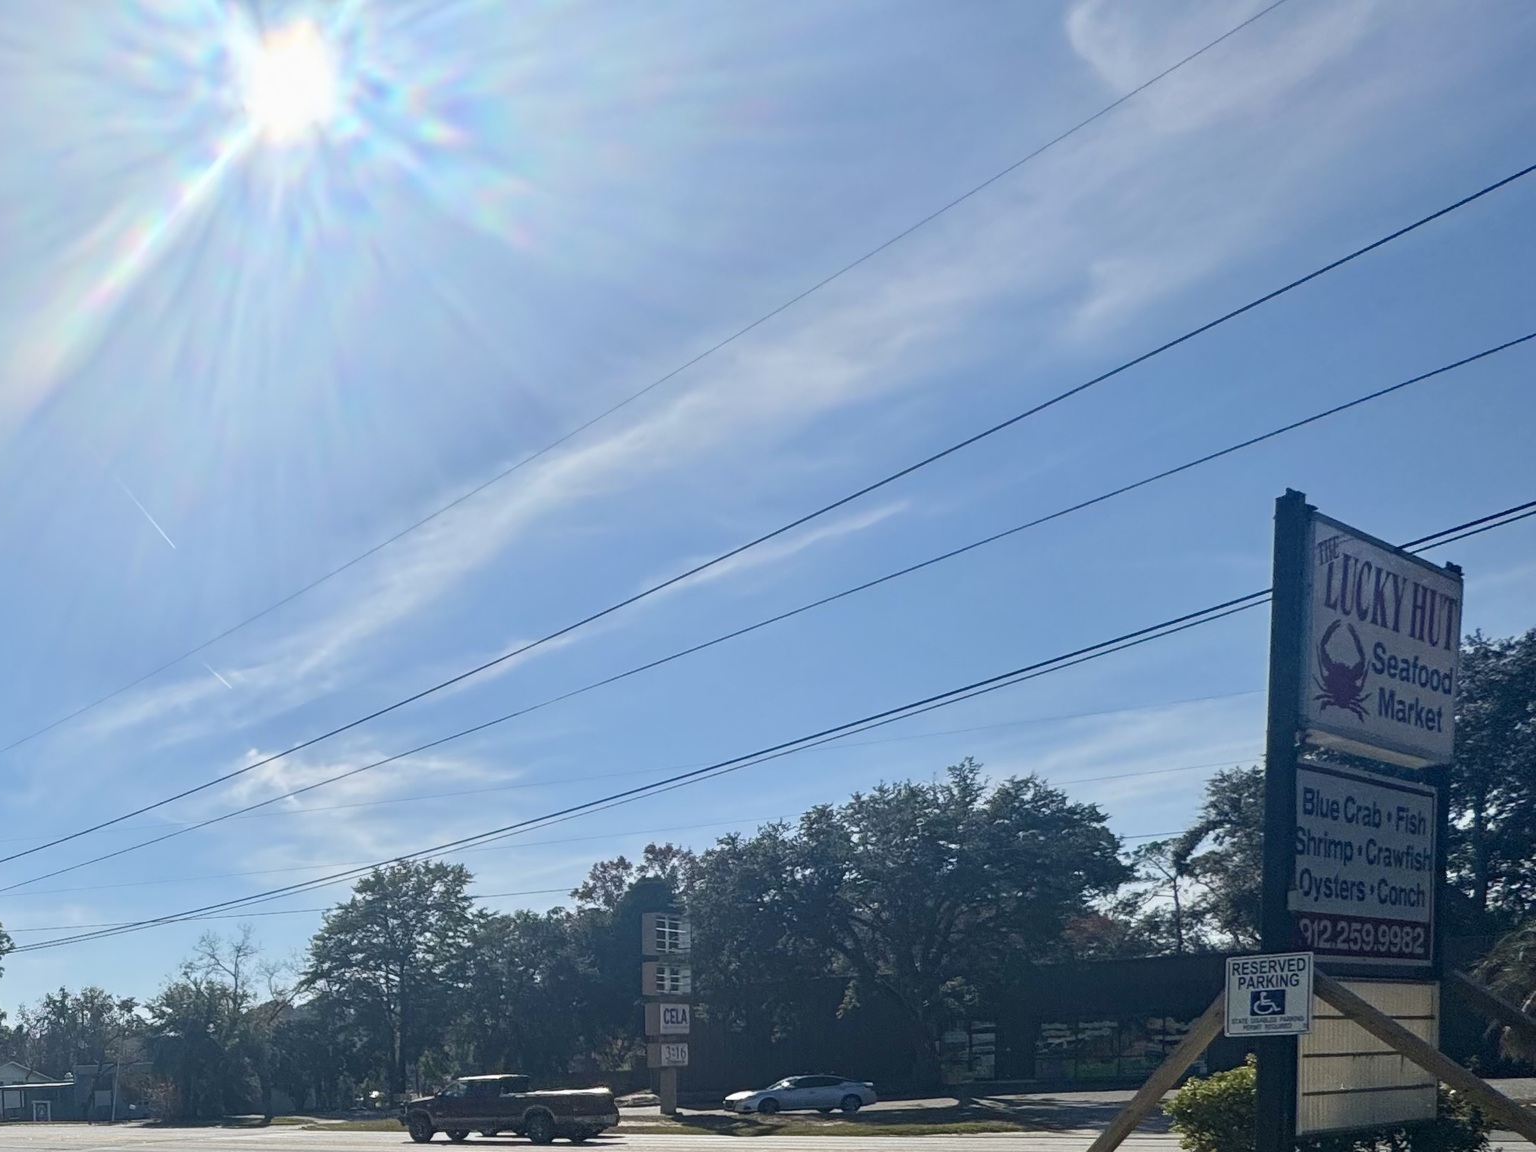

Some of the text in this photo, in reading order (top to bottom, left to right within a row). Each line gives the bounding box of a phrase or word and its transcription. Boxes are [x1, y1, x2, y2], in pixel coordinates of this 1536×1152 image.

[1317, 535, 1341, 566] THE
[1325, 553, 1458, 650] LUCKY HUT
[1371, 642, 1453, 695] Seafood
[1378, 687, 1443, 733] Market
[1302, 787, 1426, 836] Blue Crab Fish
[1296, 826, 1432, 873] Shrimp Crawfish
[1299, 868, 1425, 908] Oysters Conch
[1299, 918, 1424, 954] 912.259.9982
[1231, 957, 1306, 976] RESERVED
[1238, 973, 1300, 991] PARKING
[663, 1008, 688, 1025] CELA
